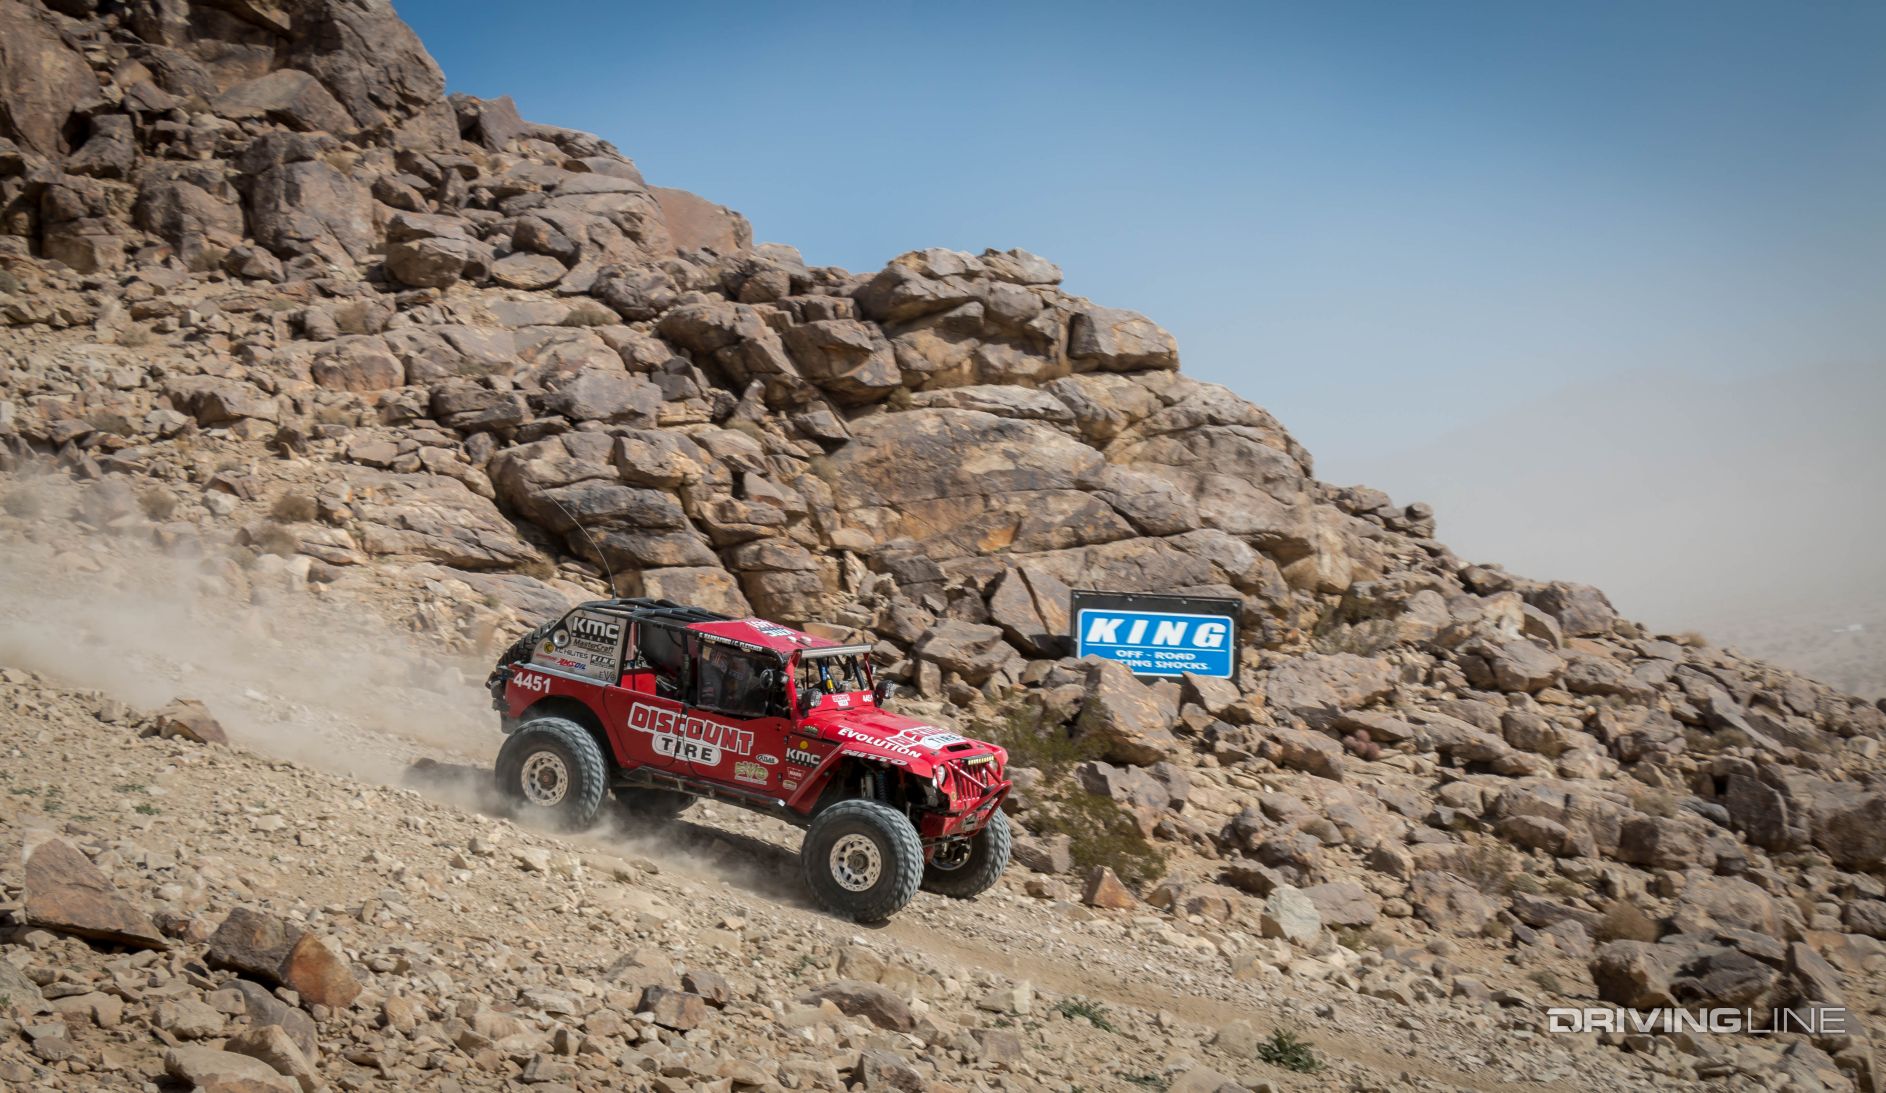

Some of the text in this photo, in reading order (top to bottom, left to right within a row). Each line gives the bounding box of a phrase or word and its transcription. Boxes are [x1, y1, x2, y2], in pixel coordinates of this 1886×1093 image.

[1085, 617, 1227, 648] KING
[574, 639, 615, 654] MasterCraft
[557, 657, 587, 670] AMSOIL
[591, 655, 616, 665] KING
[1115, 650, 1144, 659] OFF
[1154, 651, 1196, 661] ROAD
[1154, 660, 1209, 671] SHOCKS
[513, 672, 551, 693] 4451
[628, 703, 754, 755] DISCOUNT
[661, 737, 714, 762] TIRE
[838, 727, 922, 759] EVOLUTION
[841, 749, 909, 766] NITTO
